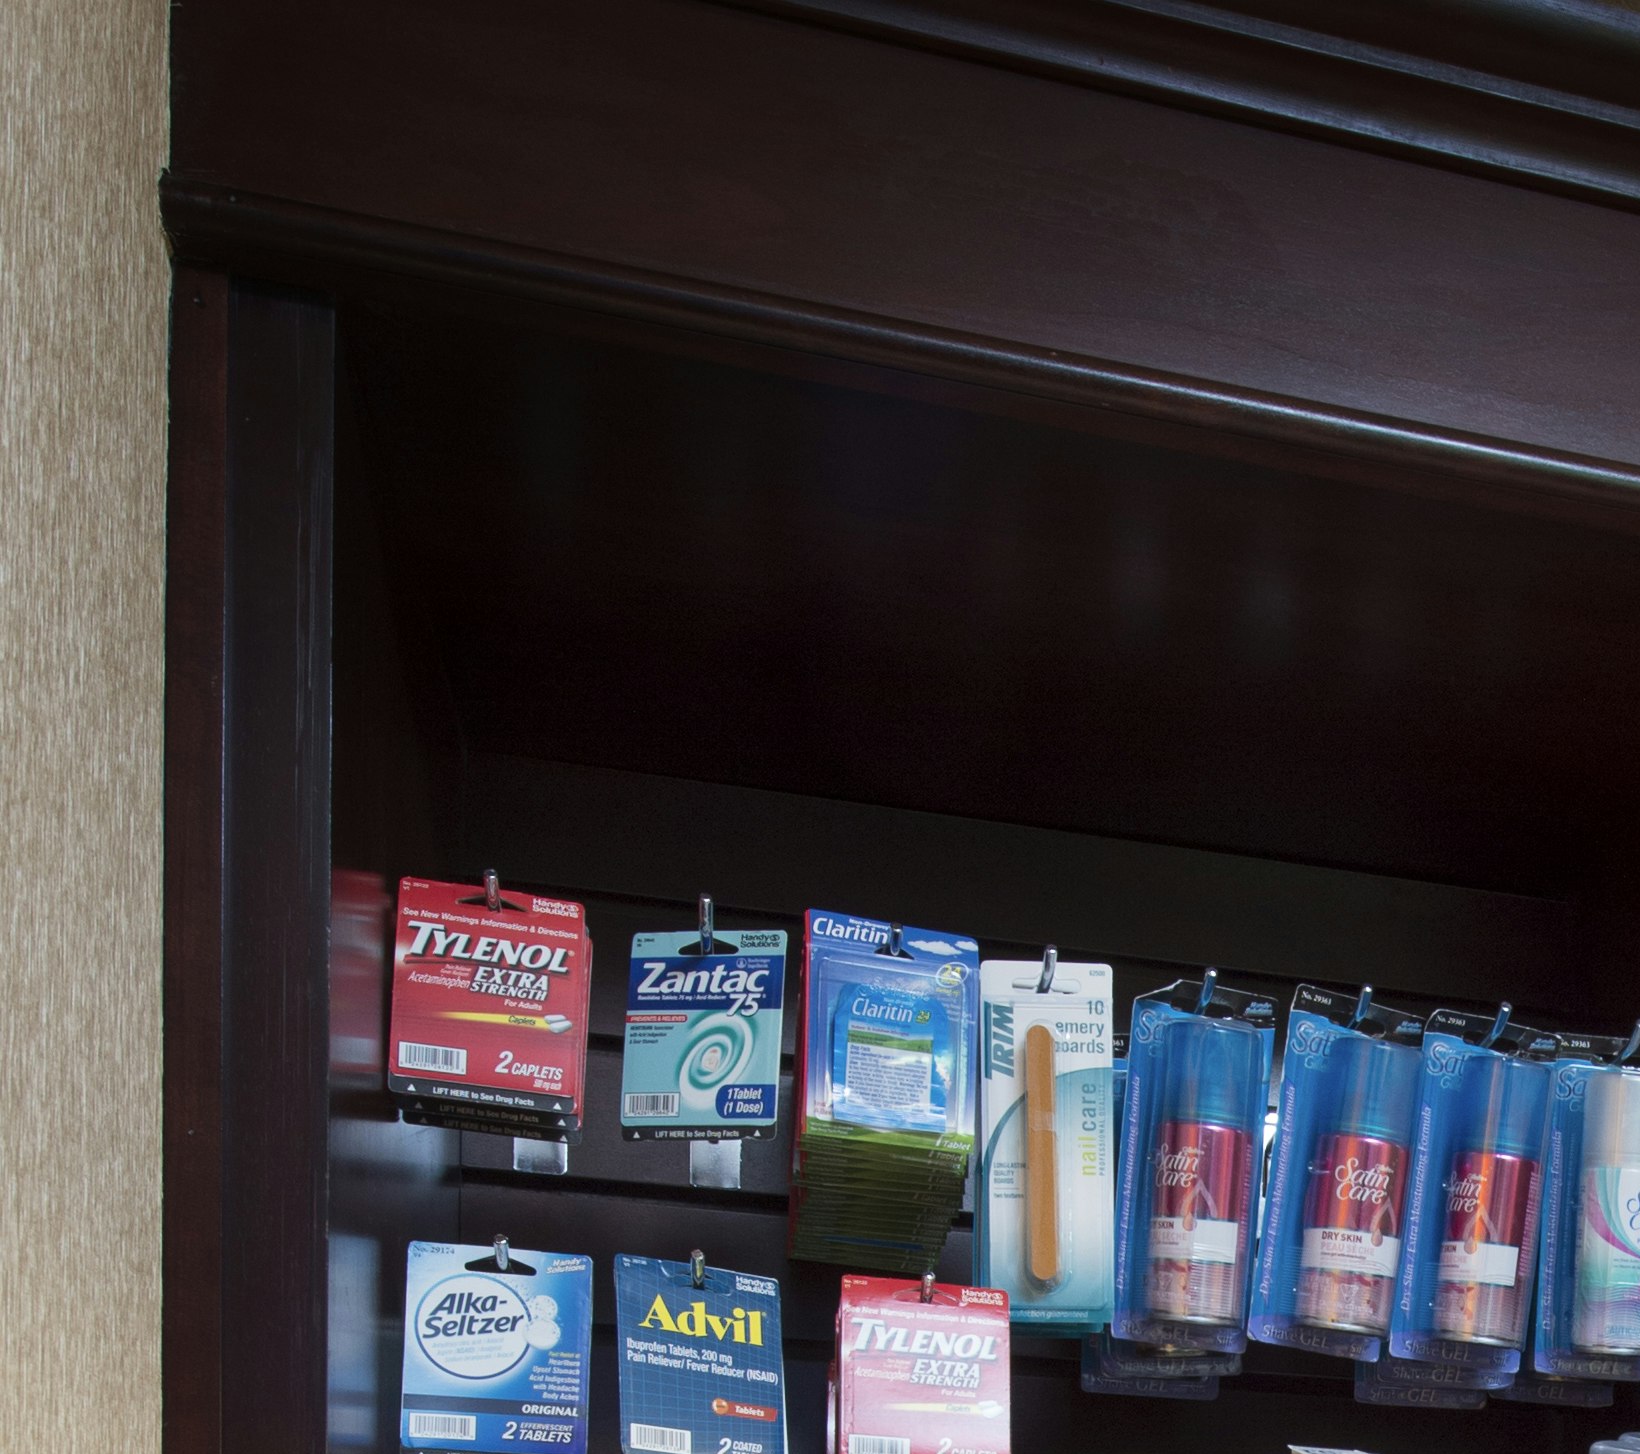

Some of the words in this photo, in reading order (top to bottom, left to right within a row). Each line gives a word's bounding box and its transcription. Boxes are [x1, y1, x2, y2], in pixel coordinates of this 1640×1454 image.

[402, 907, 419, 917] See
[420, 909, 439, 920] New
[441, 912, 479, 925] Warnings
[481, 918, 528, 932] Information
[537, 927, 579, 940] Directions
[812, 917, 888, 944] Claritin
[407, 920, 570, 973] TYLENOL
[740, 940, 780, 948] Solutions
[741, 934, 769, 942] Handy
[408, 971, 471, 989] Acetaminophen
[473, 966, 549, 991] EXTRA
[637, 962, 770, 993] Zantac
[470, 982, 548, 1001] STRENGTH
[727, 993, 761, 1016] 75
[851, 997, 913, 1023] Claritin
[1087, 1001, 1105, 1015] 10
[508, 1015, 537, 1026] Caplets
[1055, 1021, 1105, 1038] emery
[990, 1002, 1014, 1078] TRIM
[495, 1050, 514, 1074] 2
[511, 1062, 563, 1081] CAPLETS
[432, 1087, 449, 1095] LIFT
[450, 1089, 470, 1097] HERE
[471, 1091, 479, 1099] to
[480, 1092, 494, 1101] See
[496, 1094, 513, 1105] Drug
[515, 1097, 535, 1106] Facts
[1082, 1083, 1097, 1131] care
[724, 1102, 733, 1115] (1
[736, 1102, 763, 1114] Dose)
[941, 1139, 971, 1150] Tablet
[1078, 1136, 1097, 1177] nail
[1335, 1157, 1390, 1189] Satin
[1336, 1181, 1385, 1204] Care
[1322, 1231, 1339, 1240] DRY
[1341, 1234, 1362, 1242] SKIN
[429, 1292, 508, 1316] Alka-
[422, 1314, 524, 1339] Seltzer
[639, 1294, 764, 1346] Advil
[850, 1317, 998, 1361] TYLENOL
[626, 1338, 667, 1354] Ibuprofen
[669, 1344, 700, 1359] Tablets,
[702, 1349, 717, 1361] 200
[719, 1354, 732, 1365] mg
[626, 1352, 646, 1364] Pain
[687, 1359, 709, 1372] Fever
[712, 1364, 745, 1377] Reducer
[747, 1369, 778, 1385] (NSAID)
[913, 1359, 980, 1378] EXTRA
[910, 1373, 979, 1389] STRENGTH
[522, 1404, 578, 1417] ORIGINAL
[735, 1405, 765, 1416] Tablets
[502, 1421, 518, 1440] 2
[520, 1422, 573, 1432] EFFERVESCENT
[519, 1431, 572, 1443] TABLETS
[733, 1442, 763, 1453] COATED
